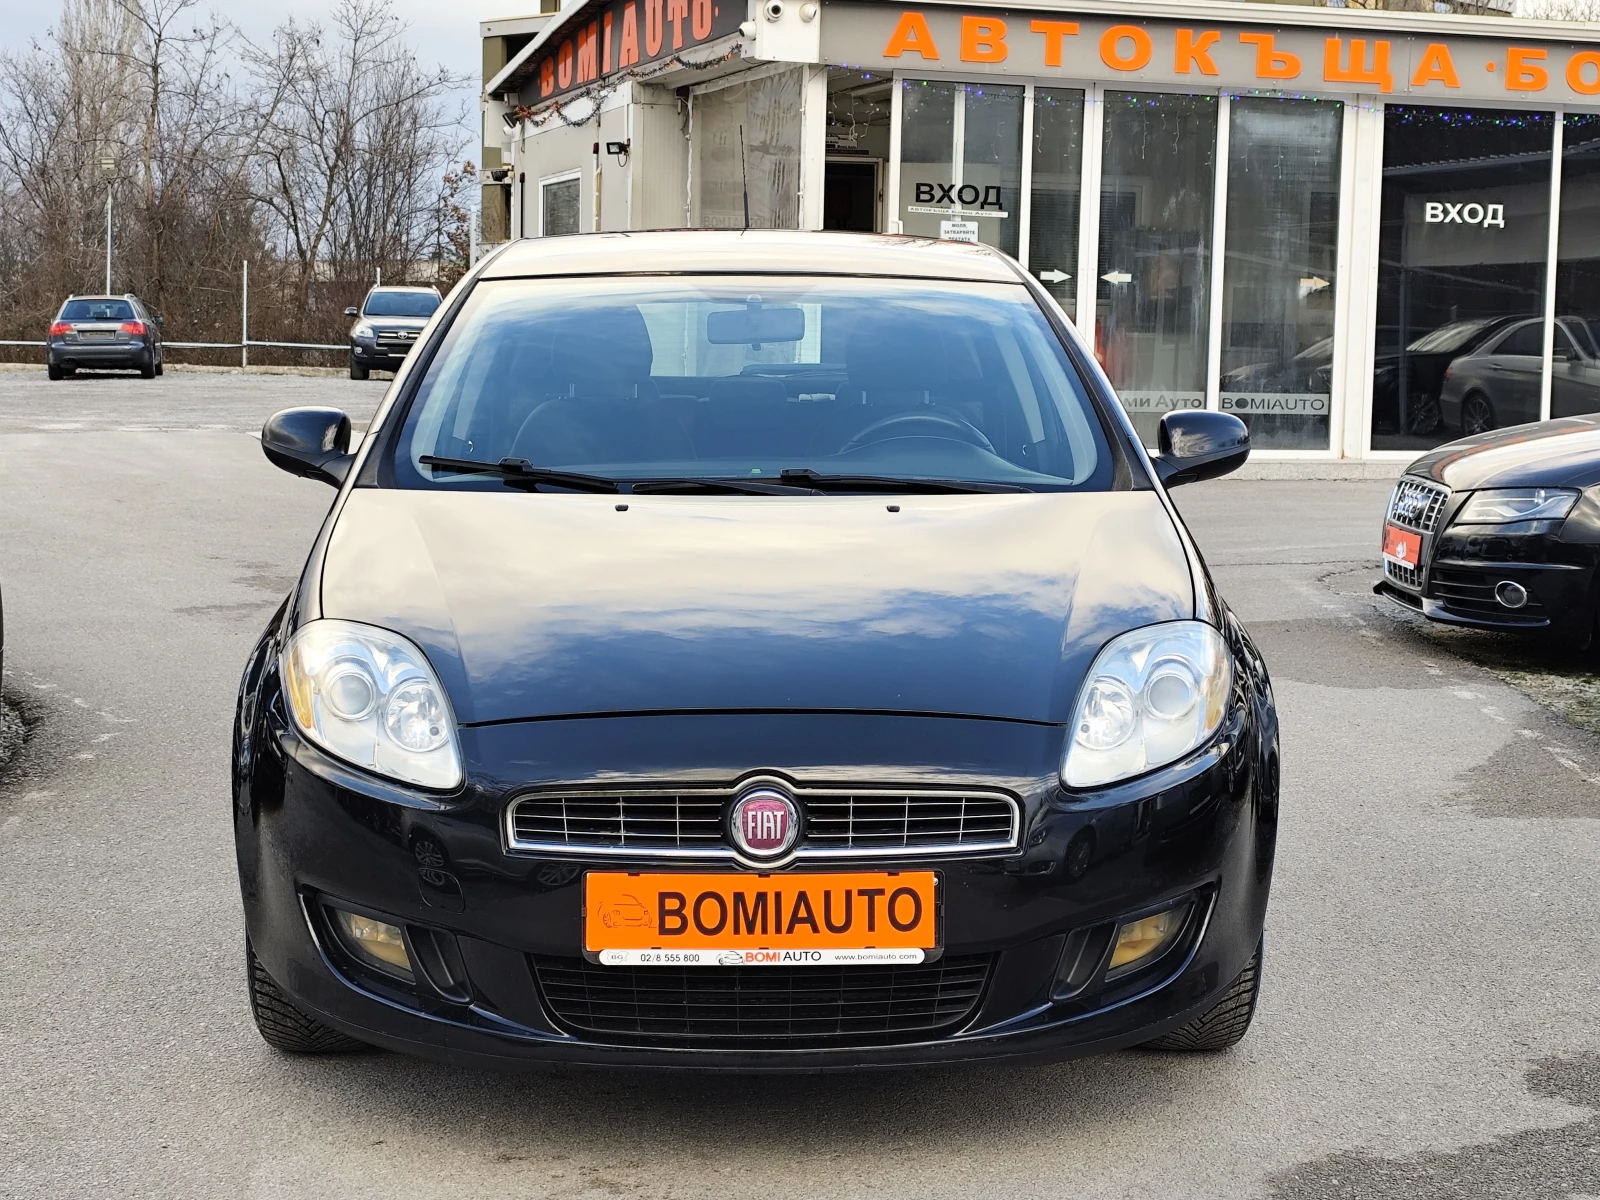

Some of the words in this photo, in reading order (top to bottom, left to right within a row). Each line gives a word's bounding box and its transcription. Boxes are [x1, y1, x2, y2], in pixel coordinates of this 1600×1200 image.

[883, 12, 1461, 93] АВТОКЪЩА
[915, 183, 1003, 210] ВХОД
[1425, 202, 1505, 228] ВХОД
[747, 811, 784, 840] FIAT
[657, 887, 922, 936] BOMIAUTO
[640, 953, 662, 963] 02/8
[664, 953, 681, 963] 555
[683, 953, 700, 963] 800
[783, 951, 822, 961] AUTO
[834, 953, 917, 961] www.bomiauto.com
